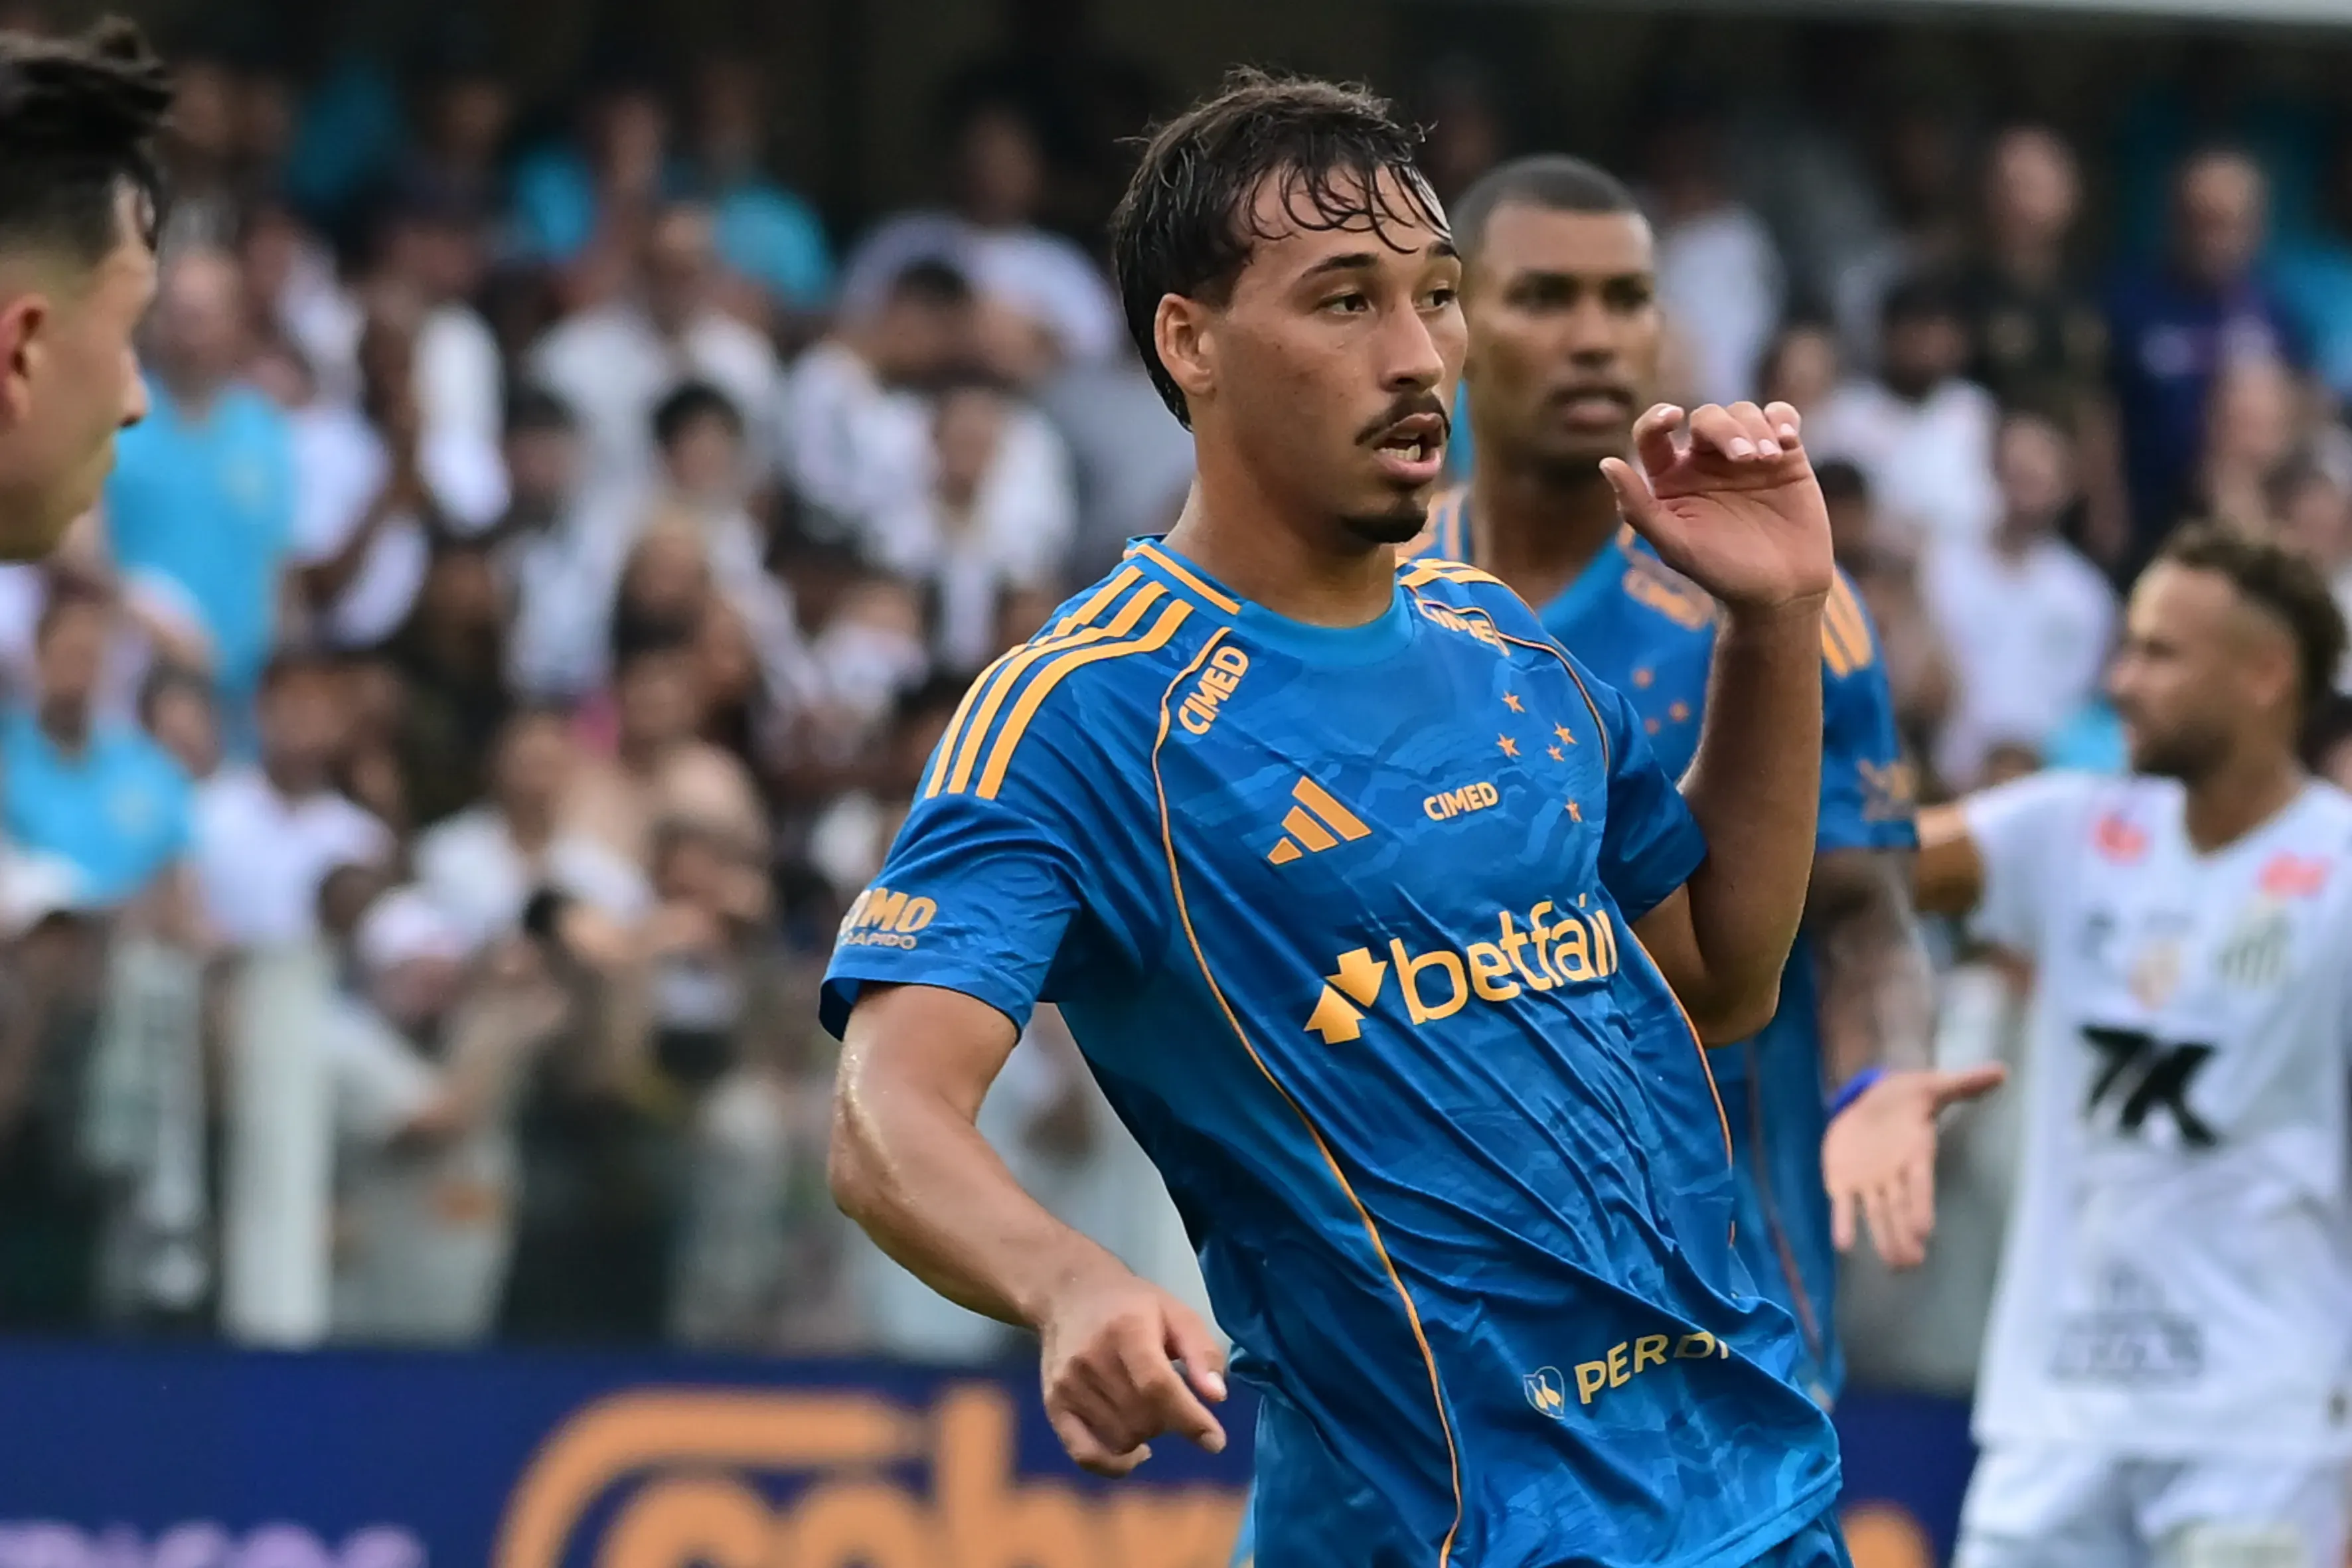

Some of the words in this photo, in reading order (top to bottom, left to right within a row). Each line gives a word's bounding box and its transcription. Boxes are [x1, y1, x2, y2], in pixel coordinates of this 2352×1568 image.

[1178, 646, 1249, 735] CIMED
[1423, 782, 1498, 821] CIMED
[2078, 1023, 2217, 1146] 7K
